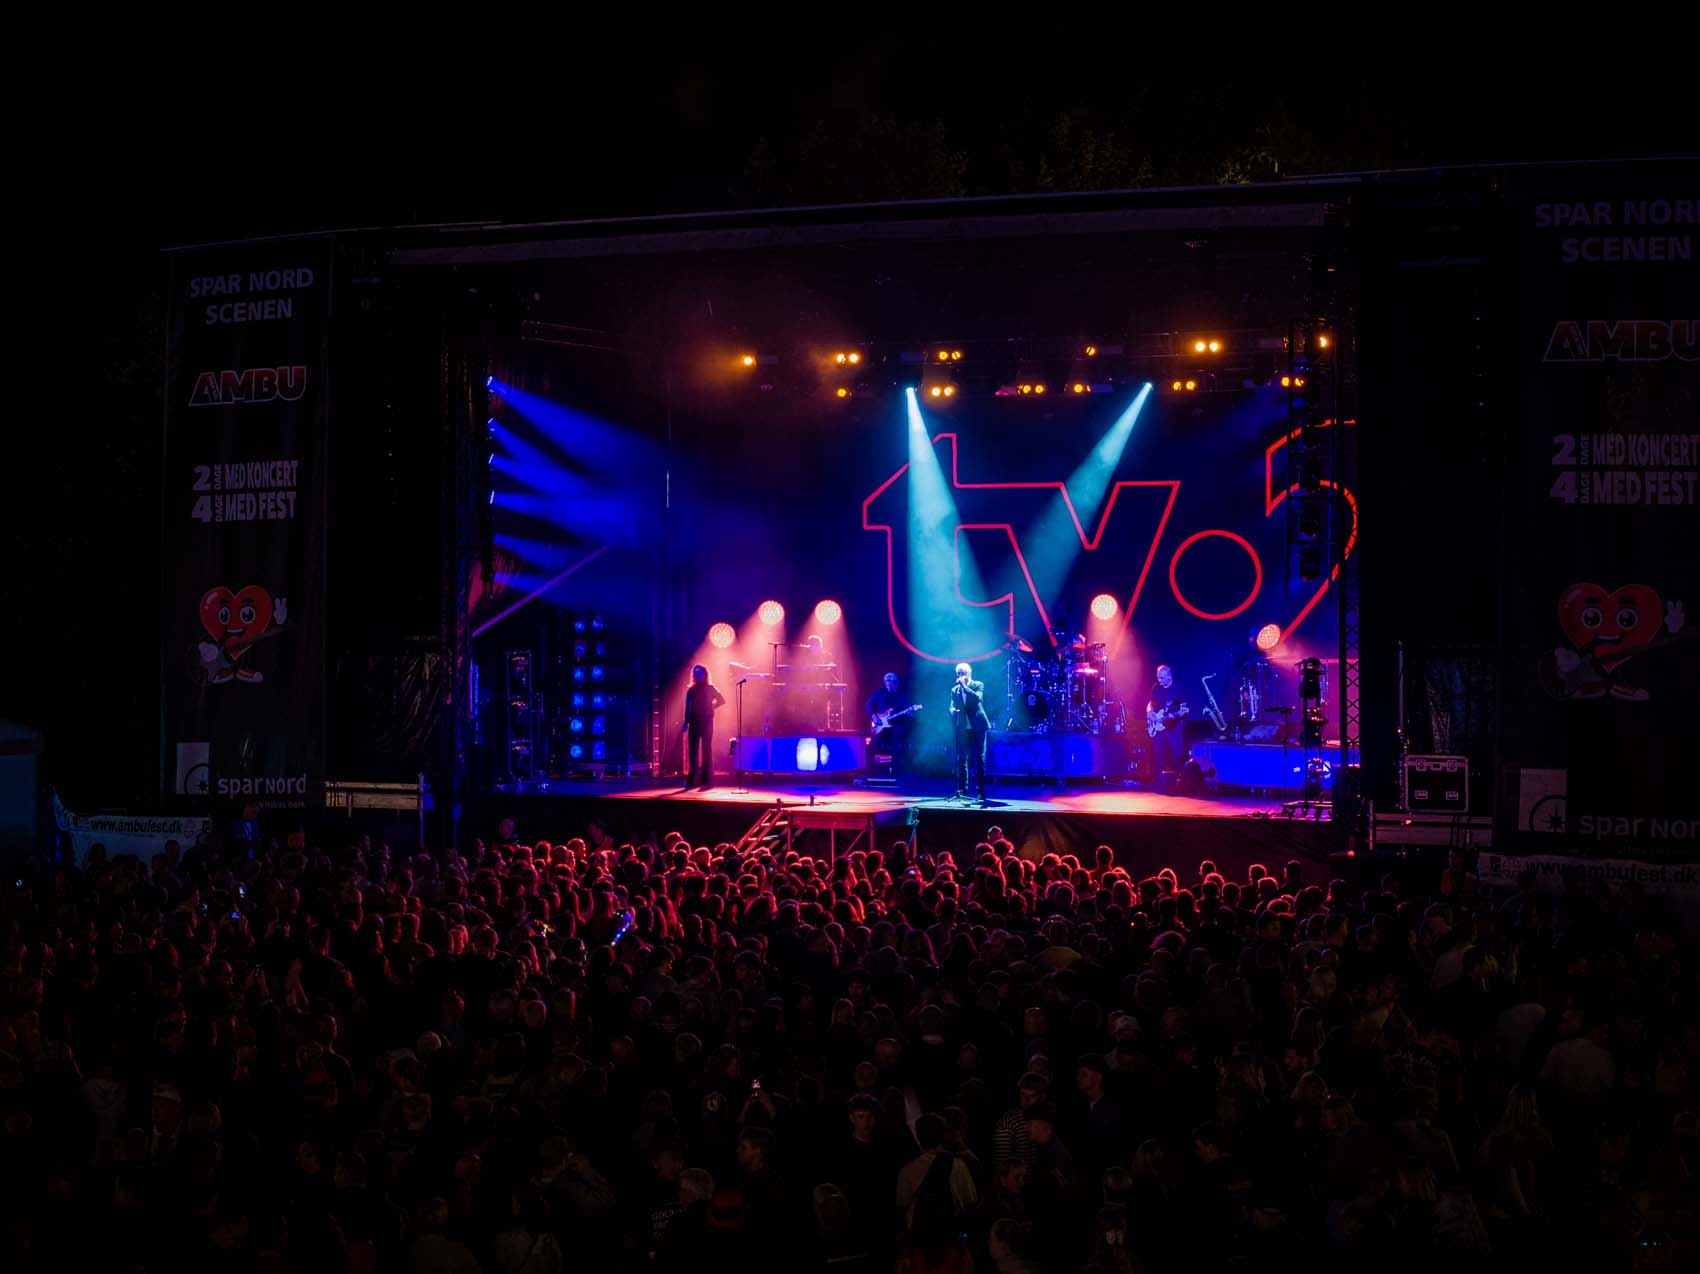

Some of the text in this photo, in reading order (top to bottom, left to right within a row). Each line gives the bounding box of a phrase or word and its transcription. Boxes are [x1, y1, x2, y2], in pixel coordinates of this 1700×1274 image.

[1535, 199, 1700, 229] SPAR NOR
[1561, 235, 1691, 262] SCENEN
[190, 267, 314, 298] SPAR NORD
[206, 297, 292, 325] SCENEN
[1542, 320, 1700, 362] AMBU
[188, 365, 307, 407] AMBU
[1551, 433, 1576, 465] 2
[1592, 432, 1626, 465] MED
[1628, 433, 1700, 466] KONCERT
[192, 464, 211, 491] 2
[224, 462, 246, 490] MED
[247, 459, 299, 489] KONCERT
[1549, 471, 1577, 504] 4
[1593, 471, 1641, 505] MED
[1645, 471, 1697, 505] FEST
[191, 495, 212, 522] 4
[224, 492, 257, 521] MED
[258, 491, 297, 520] FEST
[91, 819, 181, 834] www.ambufest.dk
[1526, 862, 1697, 881] wwwambufest.dk
